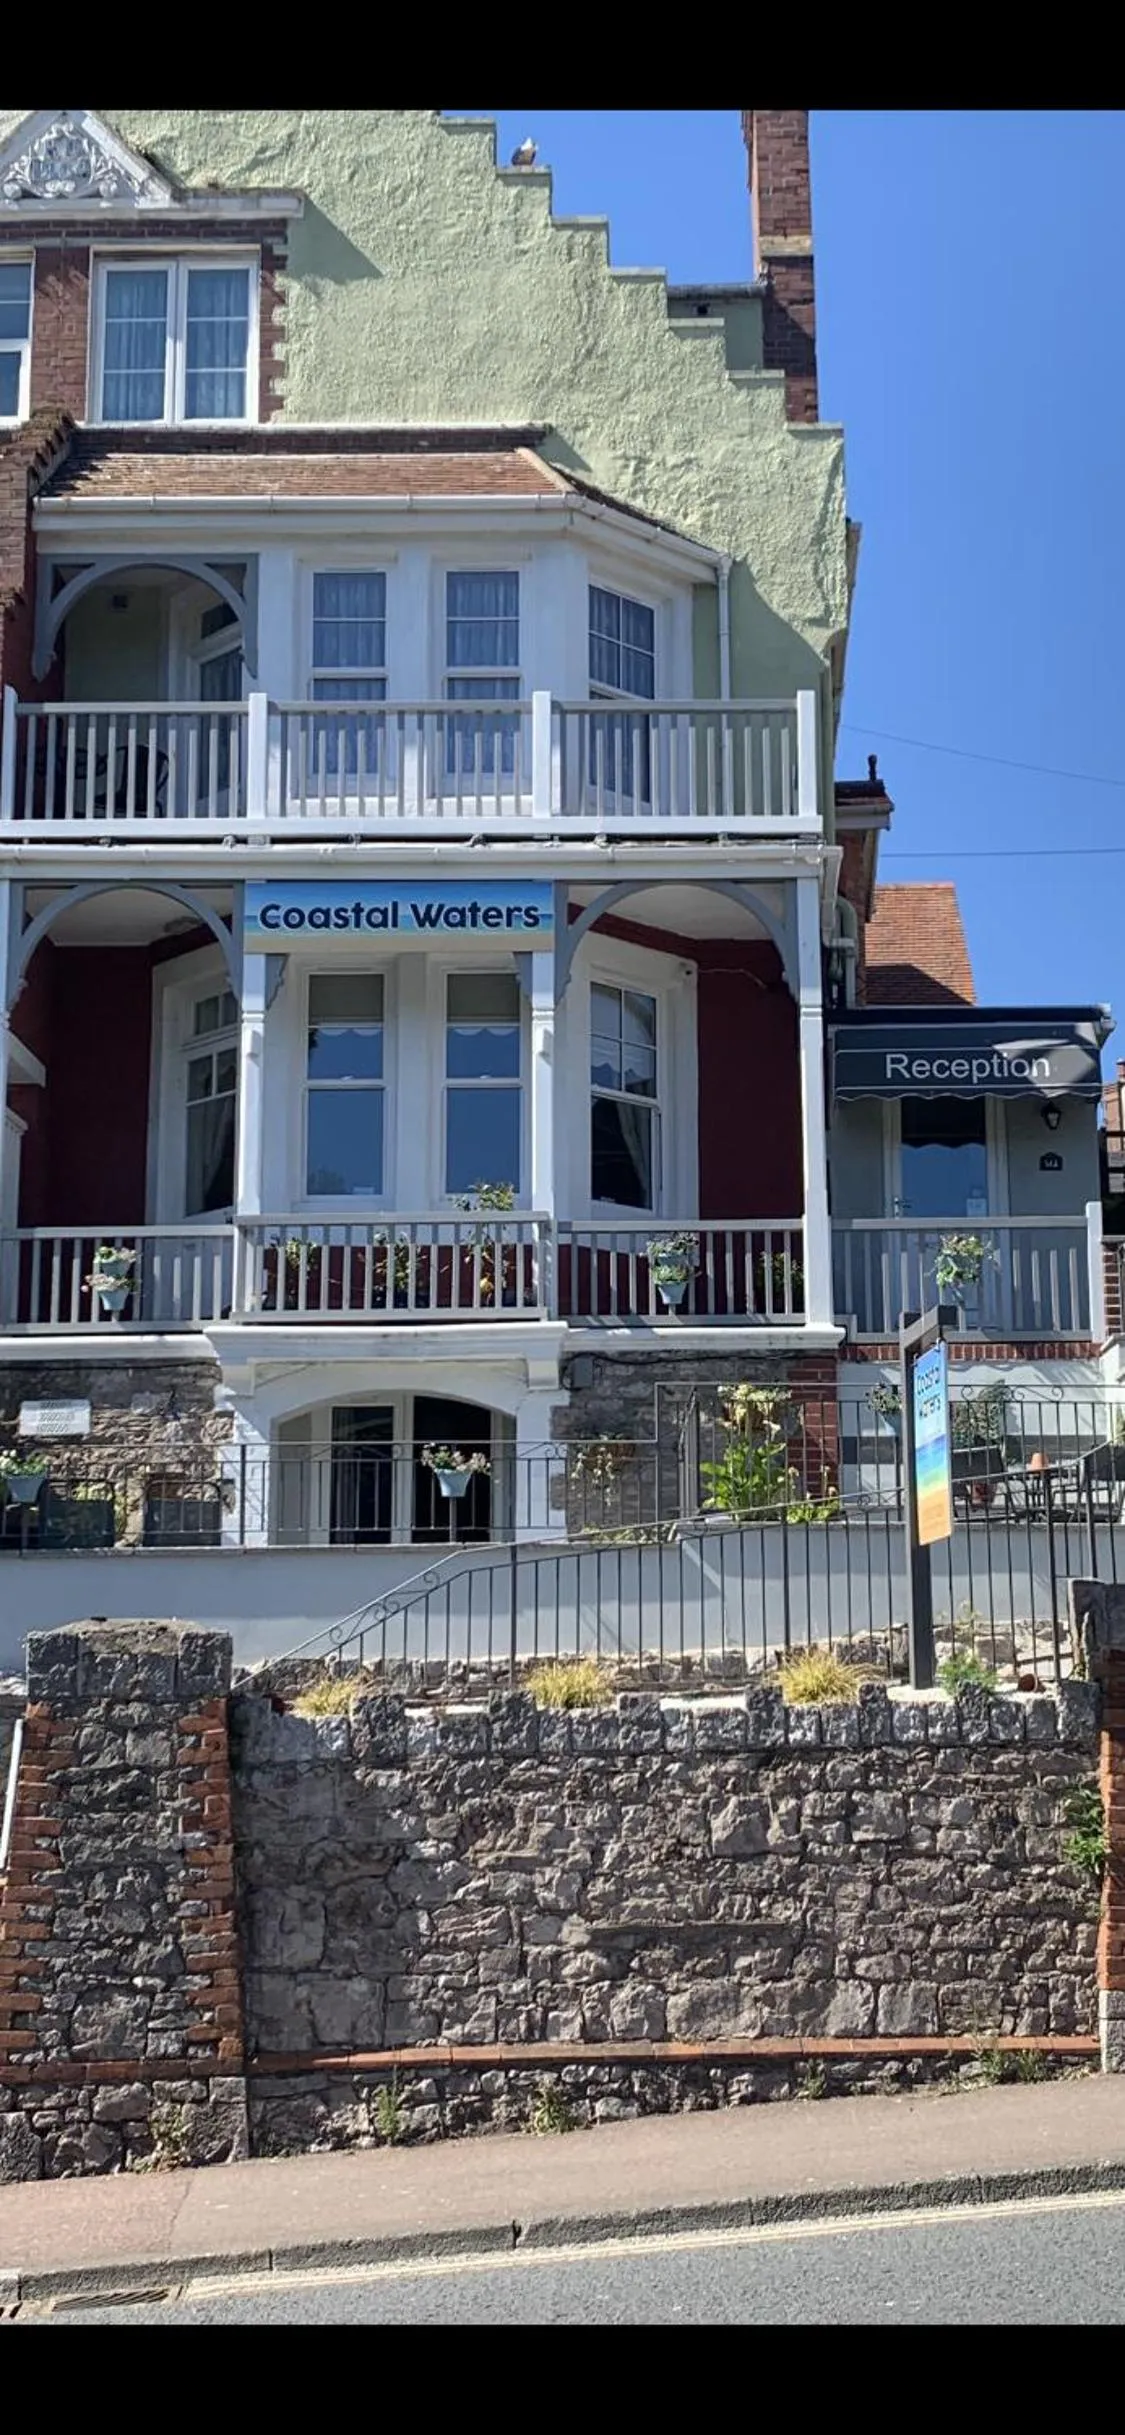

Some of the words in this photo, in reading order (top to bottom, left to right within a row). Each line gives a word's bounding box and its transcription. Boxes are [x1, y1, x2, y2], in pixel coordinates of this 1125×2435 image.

[259, 901, 399, 929] Coastal
[411, 901, 541, 928] Waters
[885, 1053, 1051, 1084] Reception
